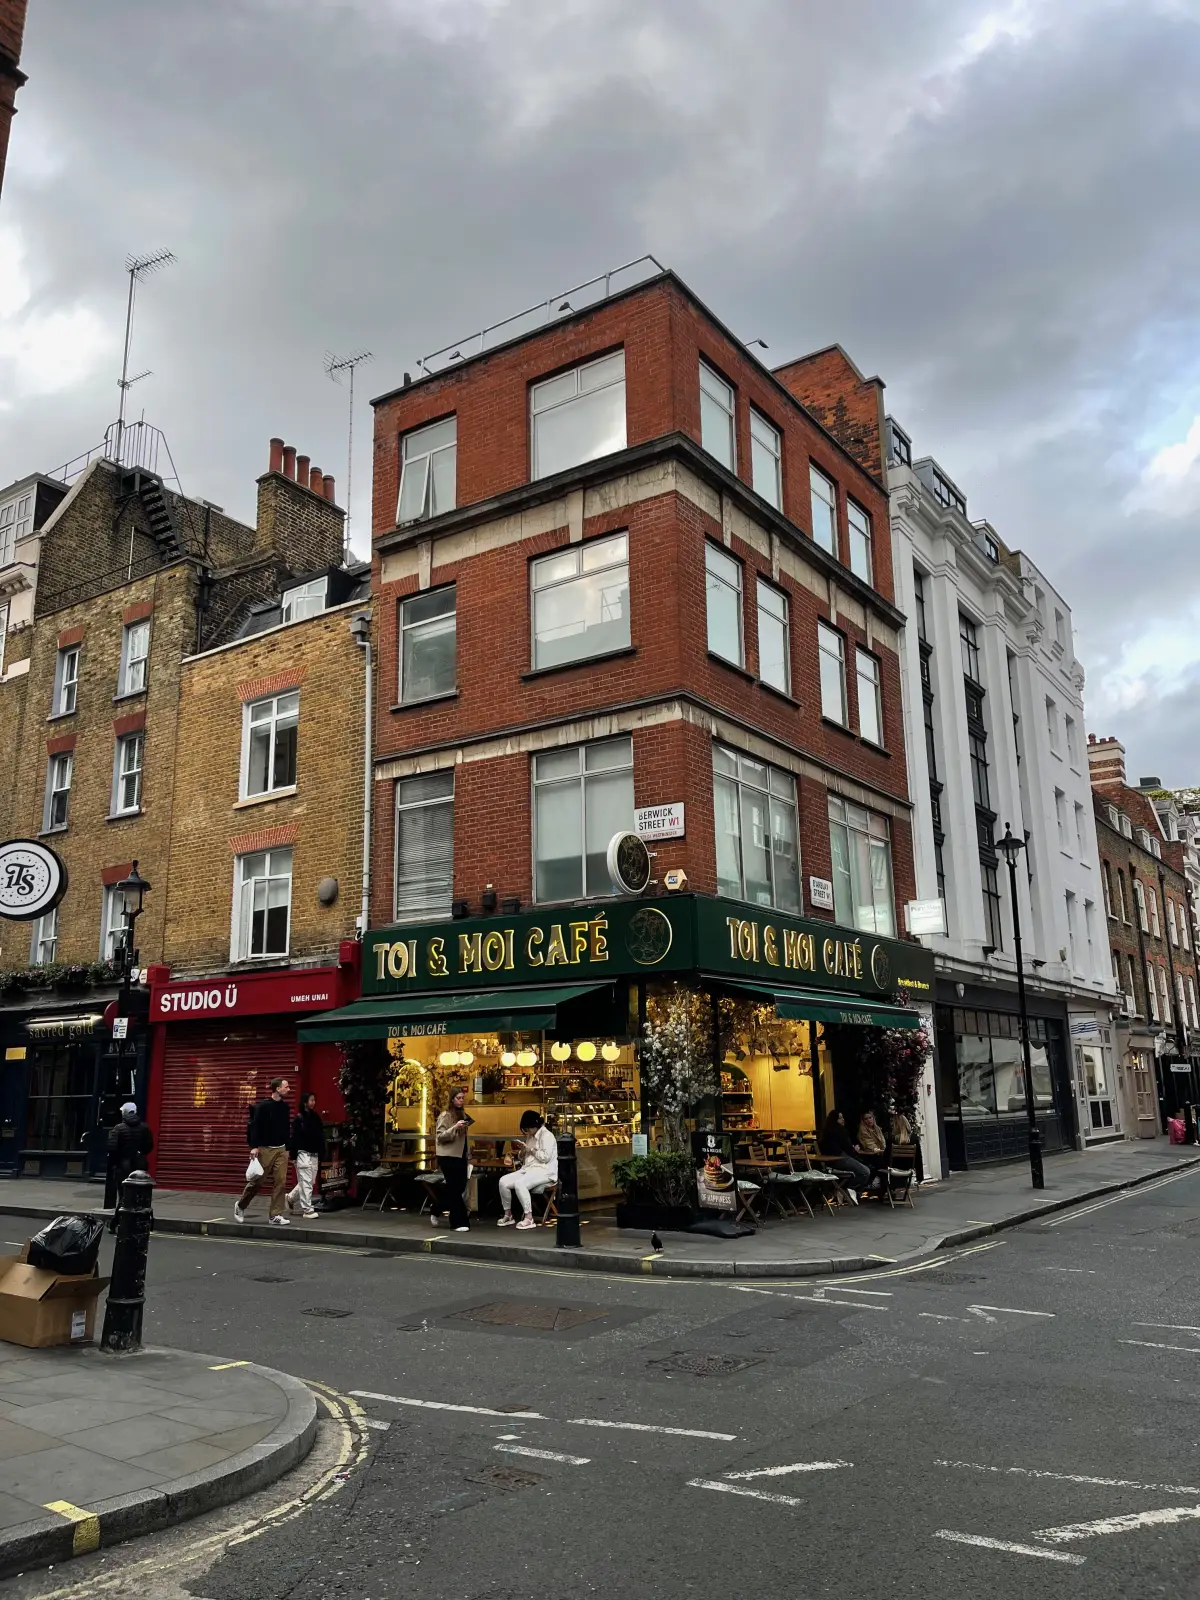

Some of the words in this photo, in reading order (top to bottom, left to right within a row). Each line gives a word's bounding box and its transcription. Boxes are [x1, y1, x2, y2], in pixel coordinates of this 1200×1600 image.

[638, 807, 673, 821] BERWICK
[638, 819, 666, 831] STREET
[668, 817, 680, 826] W1
[373, 940, 417, 980] TOI
[427, 937, 449, 976] &
[458, 929, 514, 973] MOI
[525, 911, 608, 967] CAFÉ
[726, 917, 759, 962] TOI
[764, 925, 780, 967] &
[783, 929, 816, 972] MOI
[823, 938, 863, 979] CAFÉ
[160, 989, 221, 1013] STUDIO
[225, 984, 238, 1008] Ü
[290, 994, 310, 1003] UMEH
[311, 993, 328, 1001] UNAI
[29, 1021, 64, 1039] sacred
[69, 1020, 94, 1040] gold
[388, 1026, 400, 1037] TOI
[402, 1025, 408, 1036] &
[411, 1025, 425, 1036] MOI
[427, 1021, 447, 1035] CAFÉ
